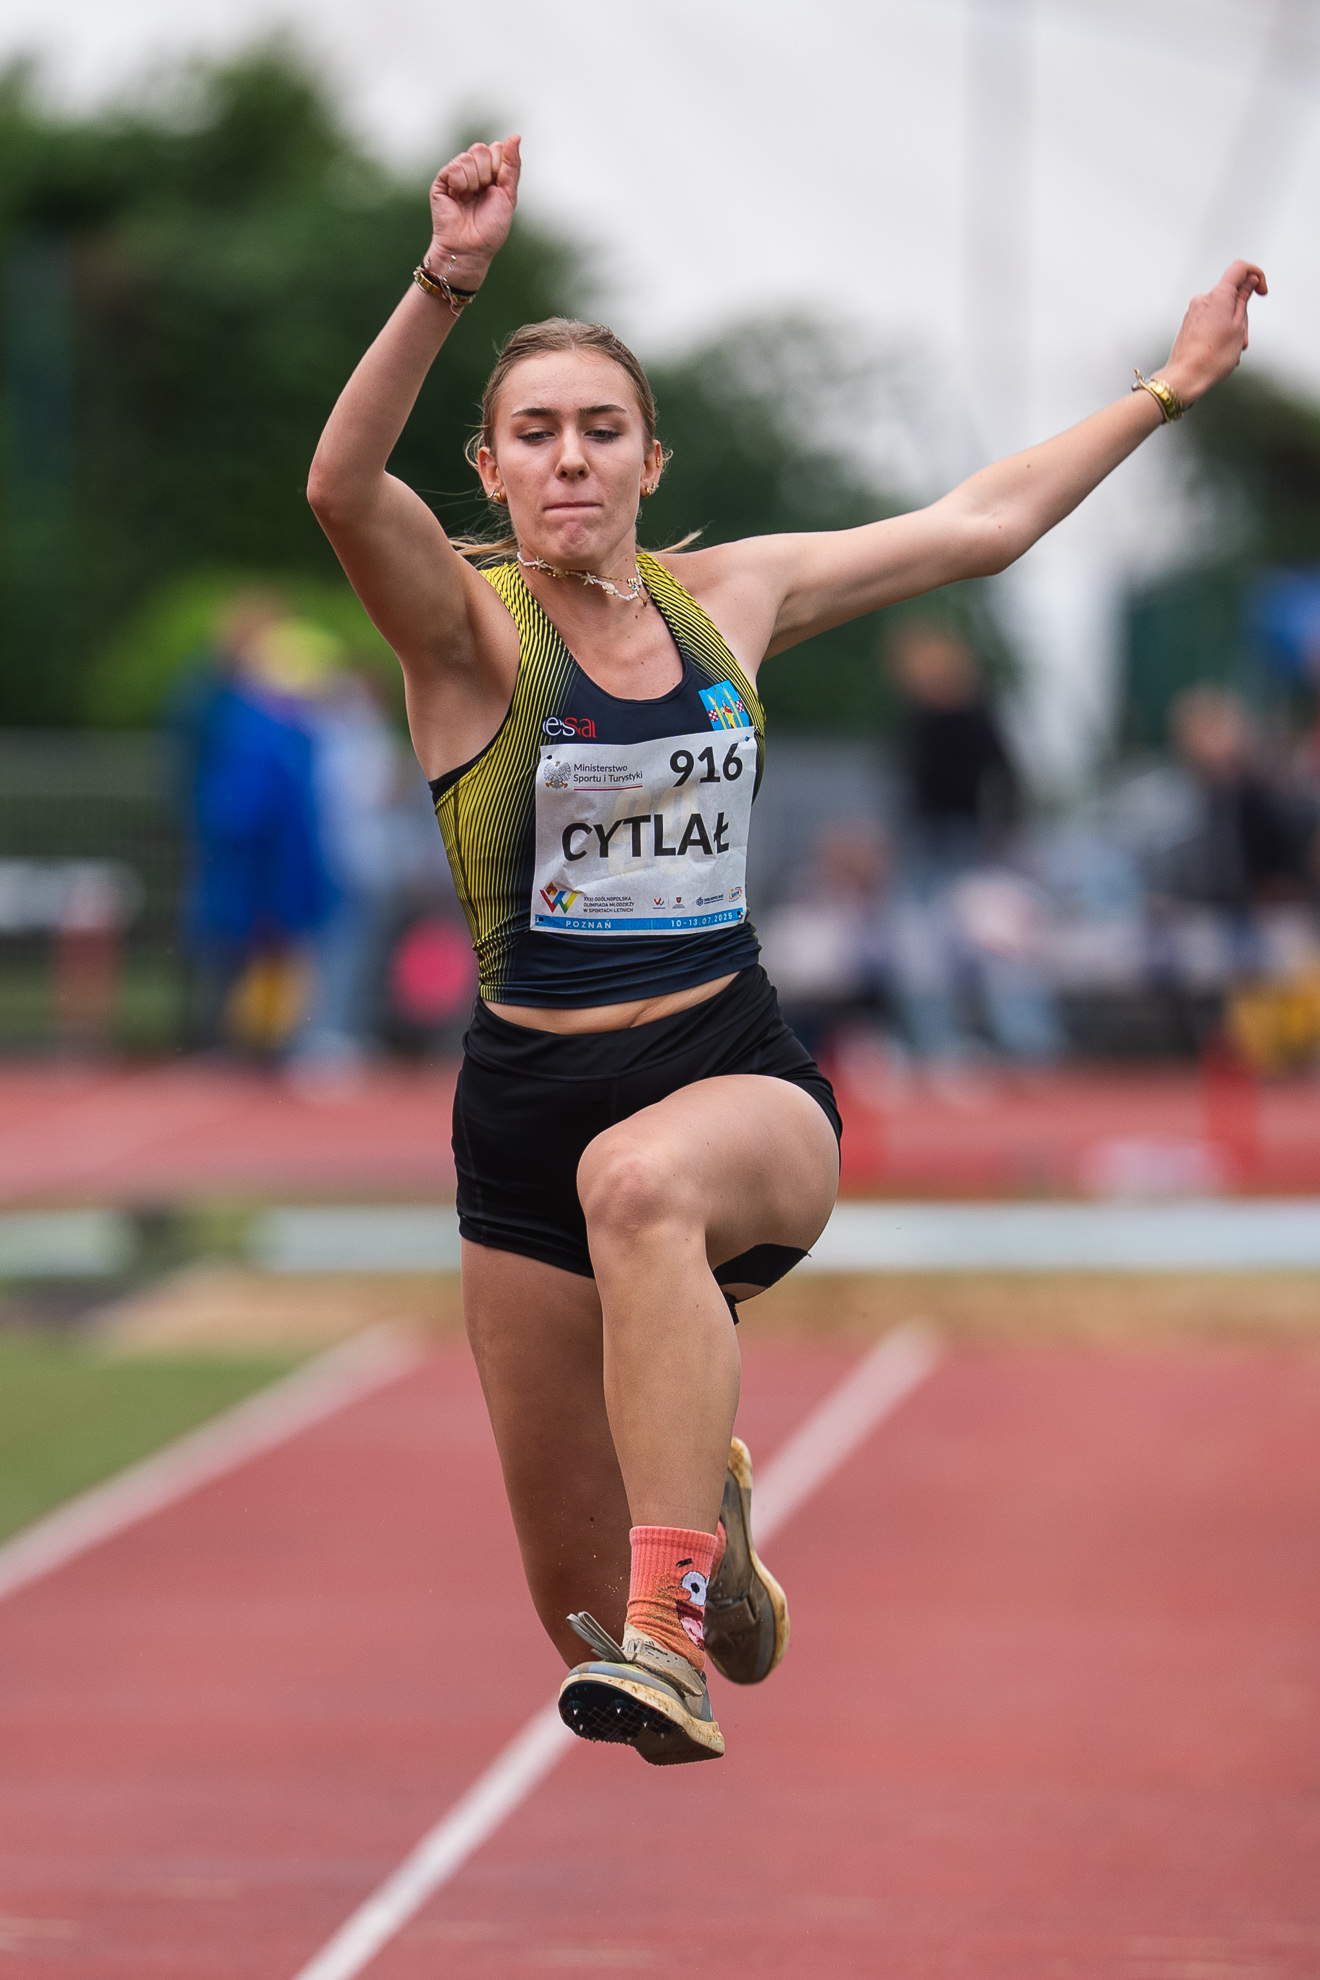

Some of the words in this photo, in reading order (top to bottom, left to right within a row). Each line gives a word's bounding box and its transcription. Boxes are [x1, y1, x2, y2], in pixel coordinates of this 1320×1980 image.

[573, 763, 628, 773] Ministerstwo
[669, 743, 743, 787] 916
[573, 774, 602, 783] Sportu
[608, 770, 643, 783] Turystyki
[562, 812, 729, 861] CYTLAŁ
[565, 919, 612, 929] POZNAŃ
[671, 912, 733, 927] 10-13.07.2025
